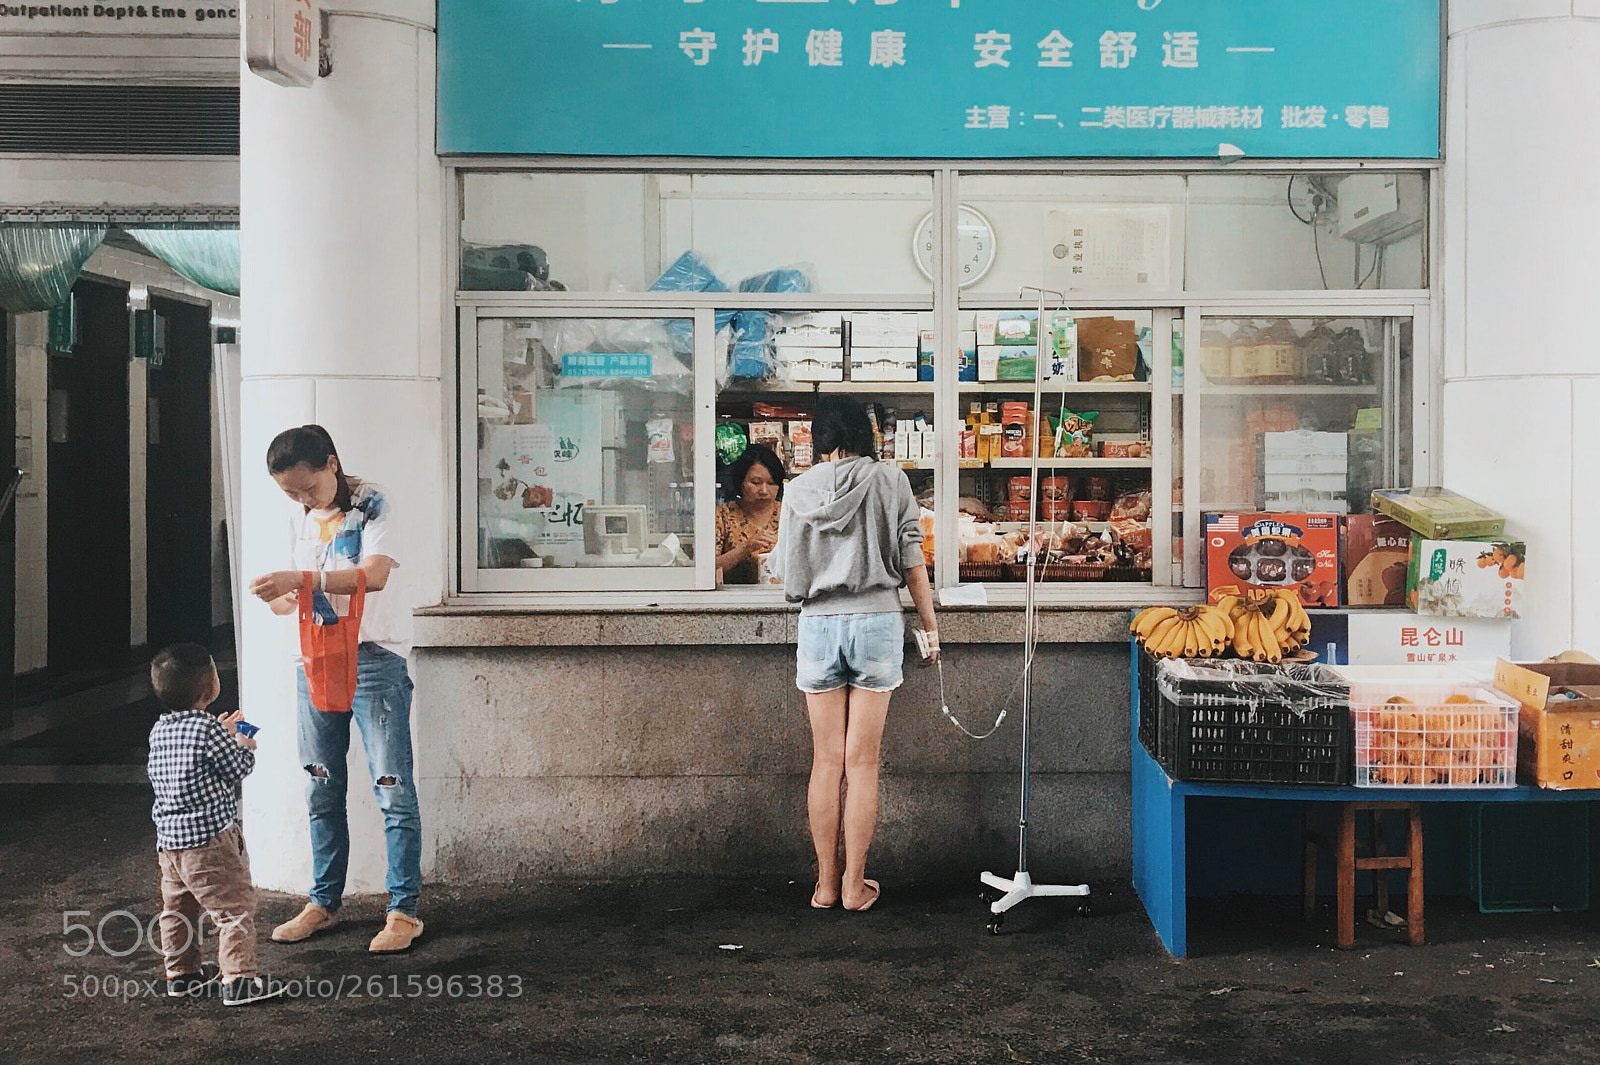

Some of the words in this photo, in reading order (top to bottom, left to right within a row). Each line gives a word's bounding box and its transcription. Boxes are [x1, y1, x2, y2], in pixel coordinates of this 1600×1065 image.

[678, 27, 907, 68] 守护健康
[973, 29, 1200, 68] 安全舒适
[972, 230, 979, 239] 2
[925, 242, 933, 251] 9
[976, 242, 983, 251] 3
[972, 254, 979, 263] 4
[963, 264, 971, 273] 5
[1400, 627, 1464, 647] 昆仑山
[1406, 653, 1457, 663] 雪山矿泉水
